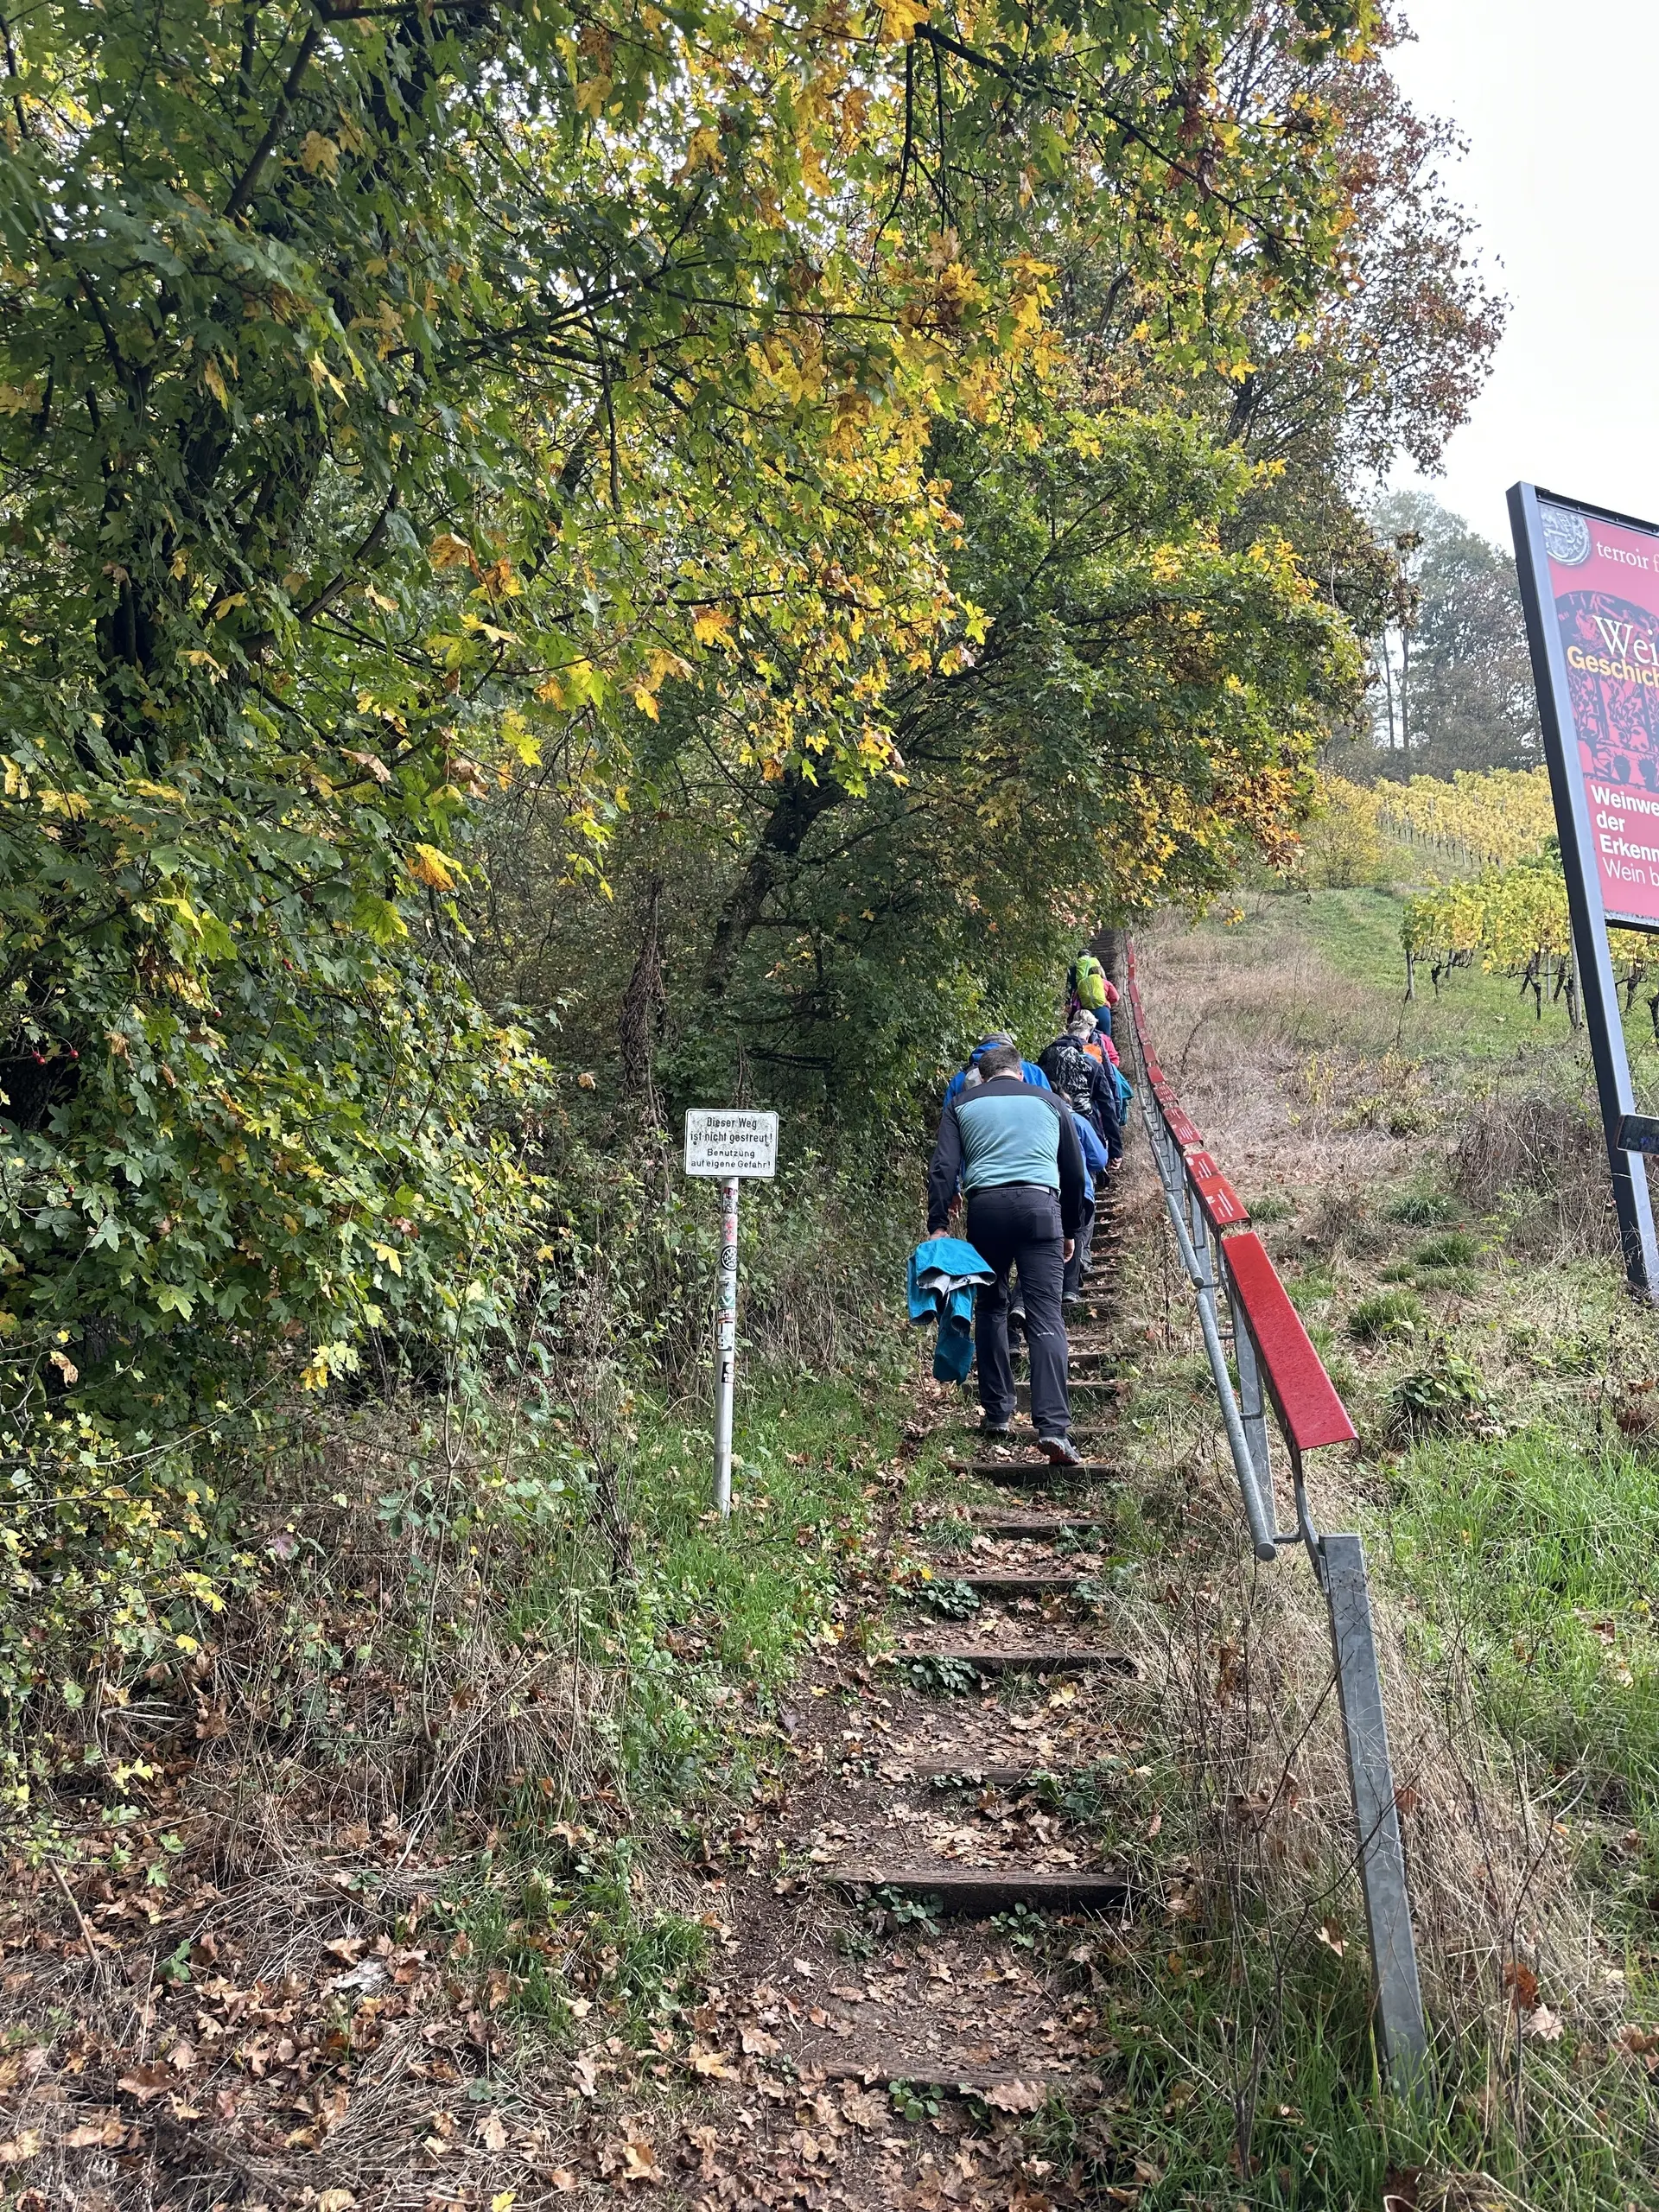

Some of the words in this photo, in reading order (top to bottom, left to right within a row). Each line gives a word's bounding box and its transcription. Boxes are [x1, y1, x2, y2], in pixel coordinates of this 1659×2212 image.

[1596, 541, 1649, 569] terroir
[1596, 810, 1625, 832] der
[1602, 856, 1645, 884] Wein
[707, 1117, 735, 1128] Dieser
[738, 1118, 757, 1131] Weg
[690, 1131, 702, 1141] ist
[704, 1132, 727, 1141] nicht
[707, 1148, 755, 1159] Benutzung
[706, 1160, 736, 1169] eigene
[737, 1160, 771, 1169] Gefahr!
